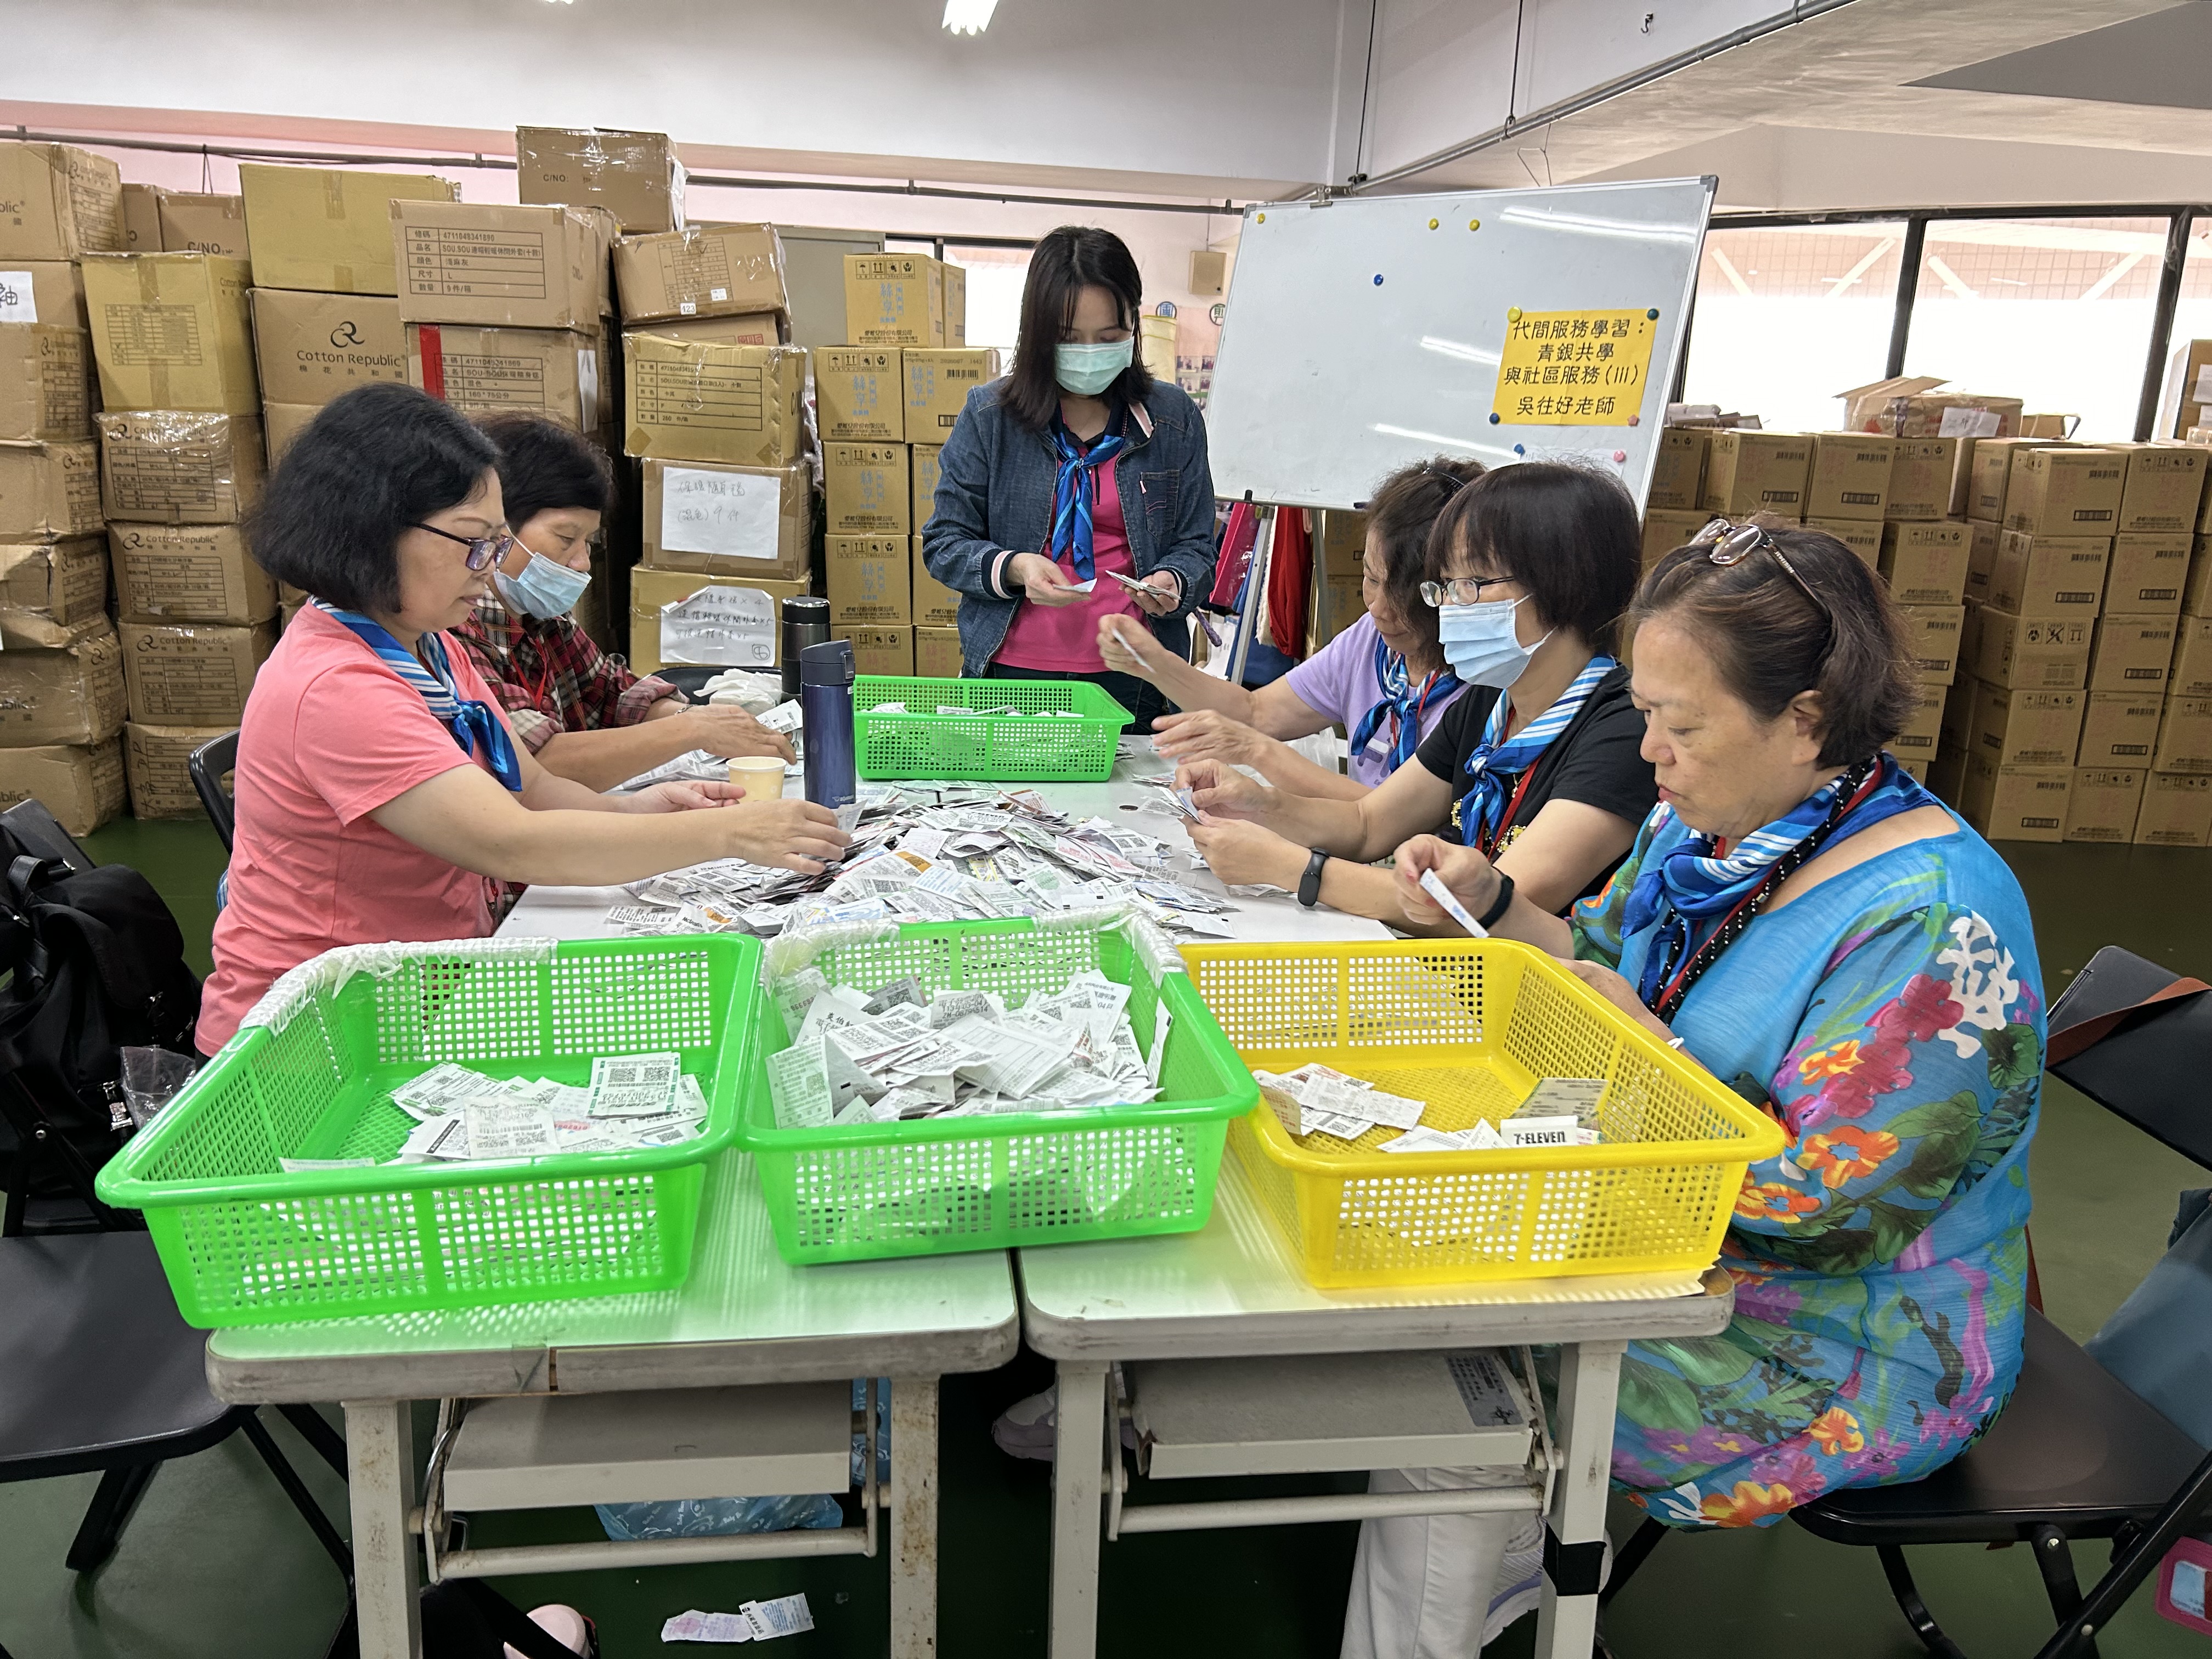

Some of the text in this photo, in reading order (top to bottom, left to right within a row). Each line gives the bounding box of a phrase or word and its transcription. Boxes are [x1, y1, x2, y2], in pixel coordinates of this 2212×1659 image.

[416, 244, 431, 252] 品名
[418, 270, 433, 278] 尺寸
[297, 350, 344, 363] Cotton
[1537, 342, 1615, 363] 青銀共學
